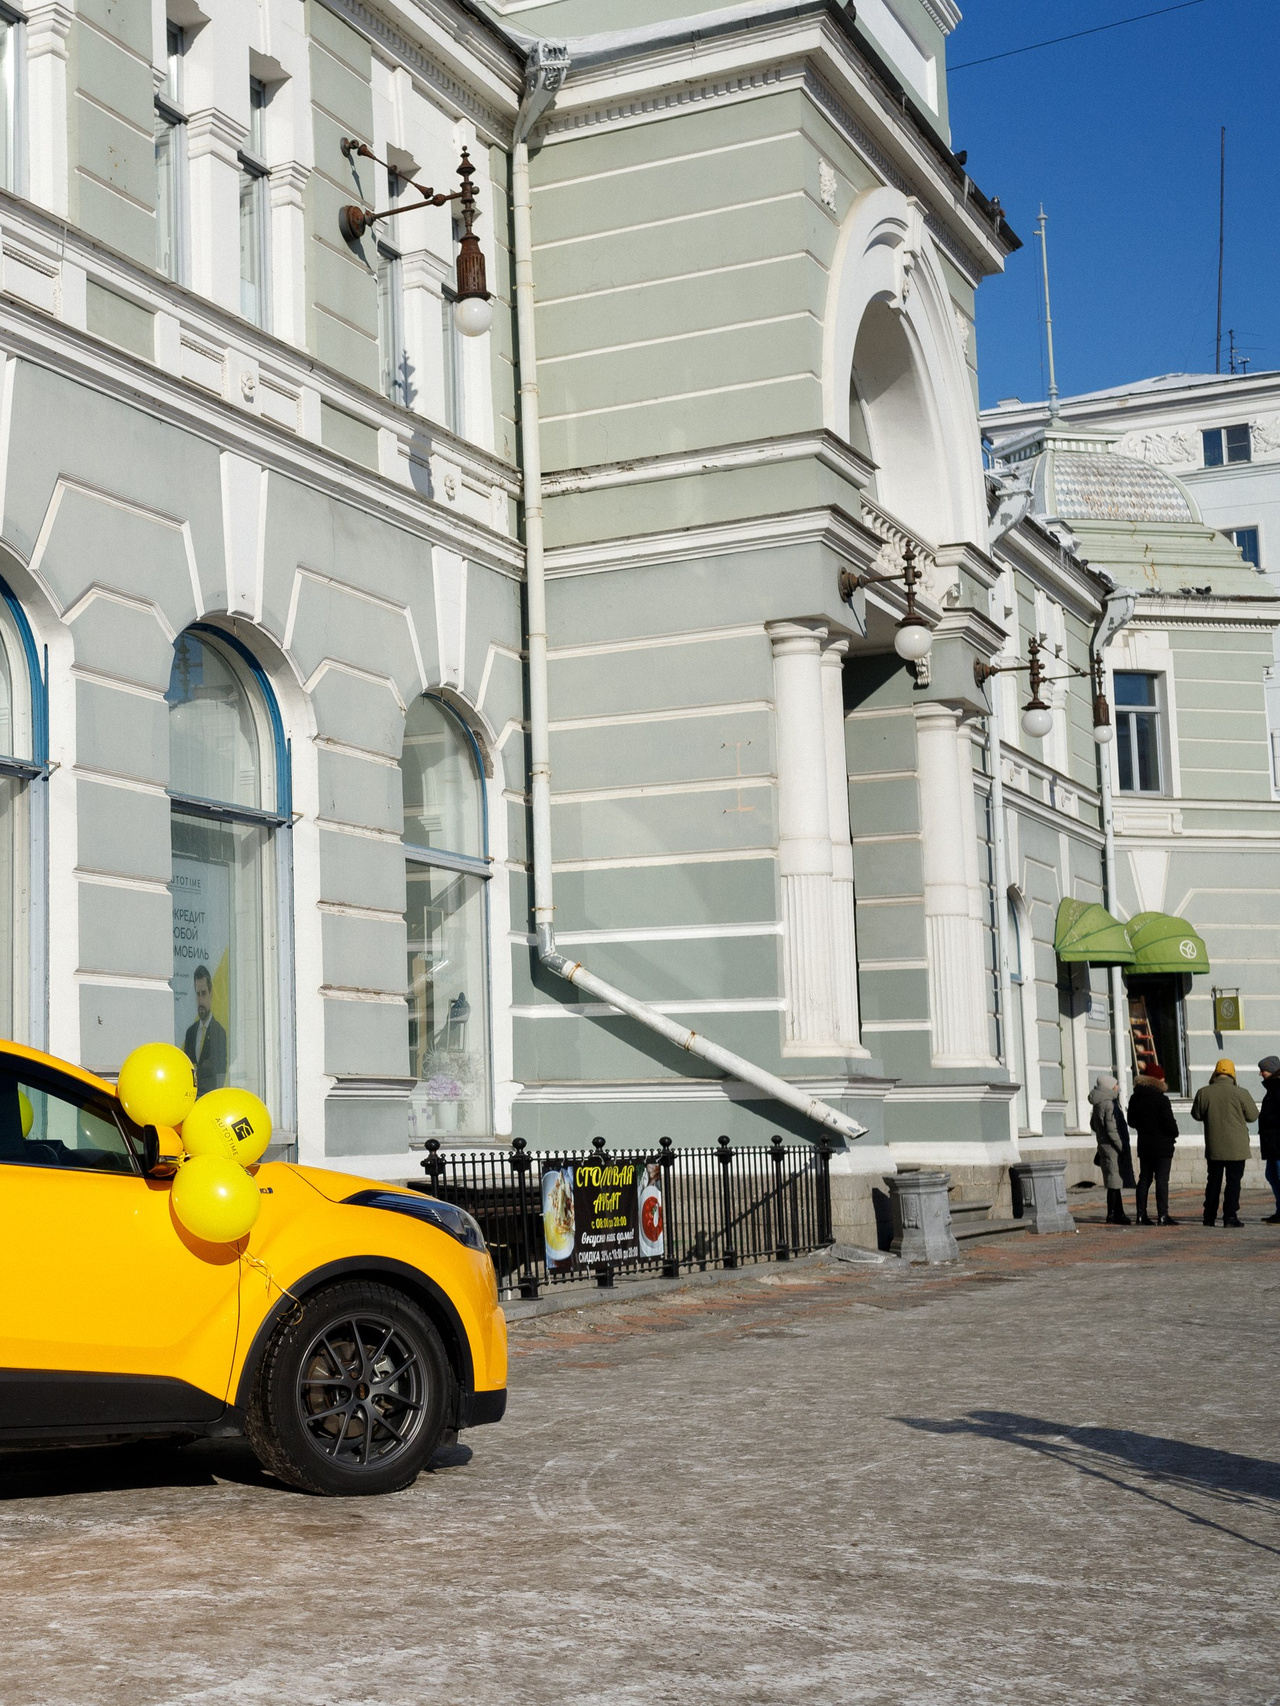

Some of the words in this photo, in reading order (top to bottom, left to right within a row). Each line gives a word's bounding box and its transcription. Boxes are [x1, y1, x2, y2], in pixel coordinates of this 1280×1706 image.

[171, 875, 201, 888] UTOTIME
[173, 908, 205, 924] КРЕДИТ
[173, 926, 199, 940] ЮБОЙ
[173, 945, 209, 960] МОБИЛЬ
[215, 1117, 239, 1156] AUTOTIME
[576, 1165, 635, 1189] СТОЛОВАЯ
[581, 1232, 606, 1247] Вкусно
[578, 1250, 601, 1264] СКИДКА
